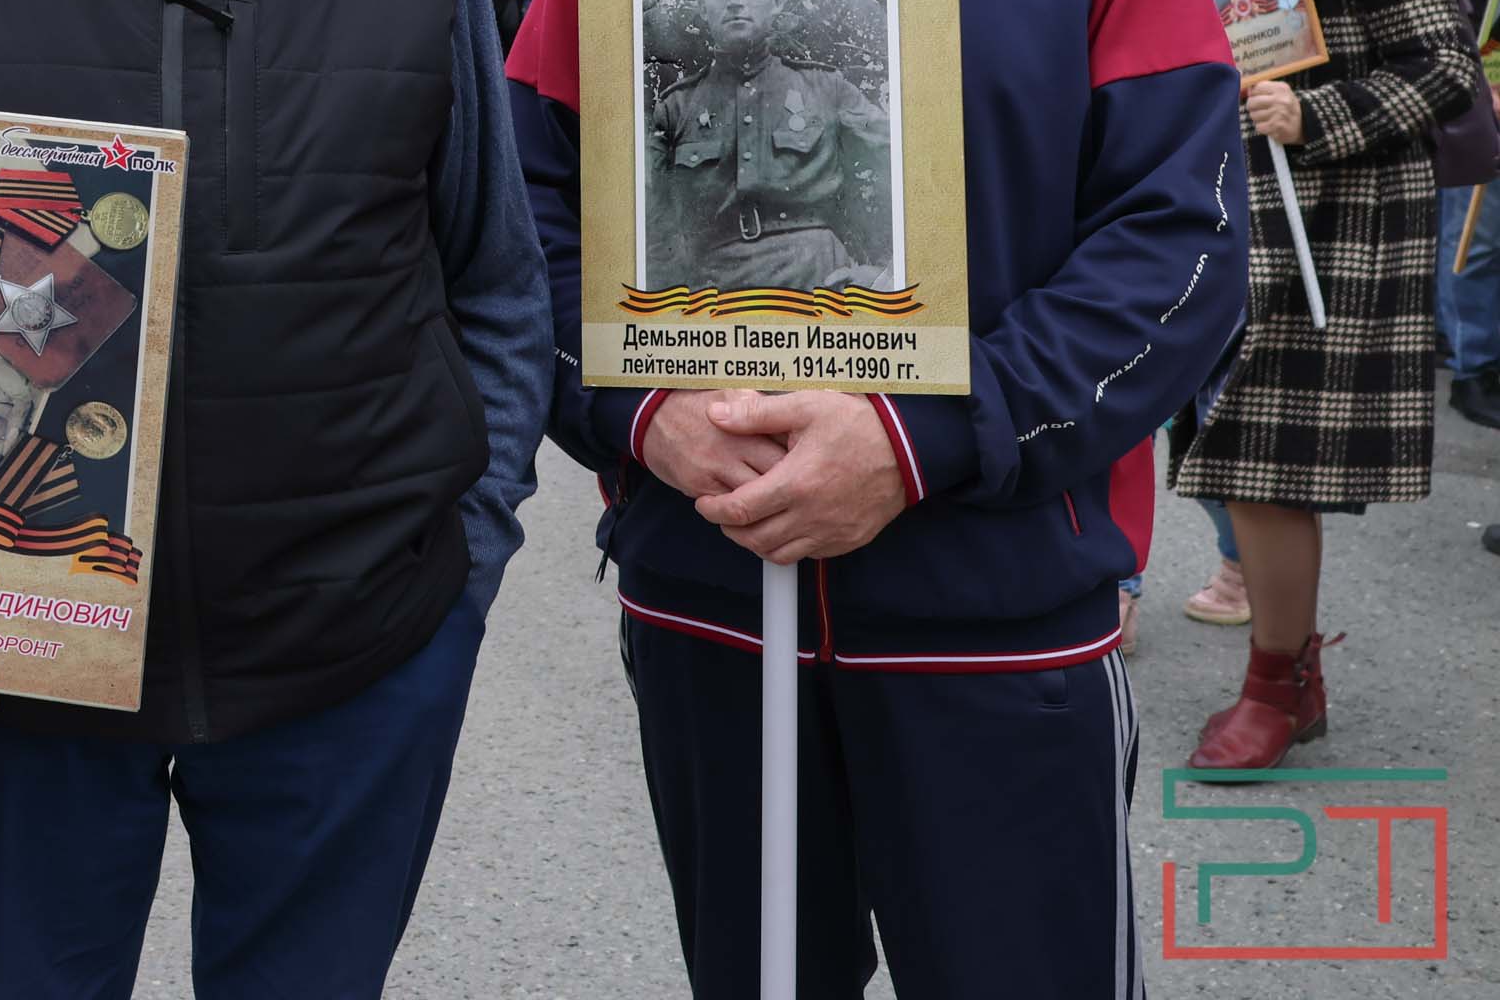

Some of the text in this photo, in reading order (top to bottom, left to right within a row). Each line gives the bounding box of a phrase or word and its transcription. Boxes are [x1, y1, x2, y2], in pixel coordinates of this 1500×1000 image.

[0, 127, 104, 165] бессмертный
[623, 323, 917, 351] Демьянов Павел Иванович
[621, 353, 920, 381] лейтенант связи, 1914-1990 гг.
